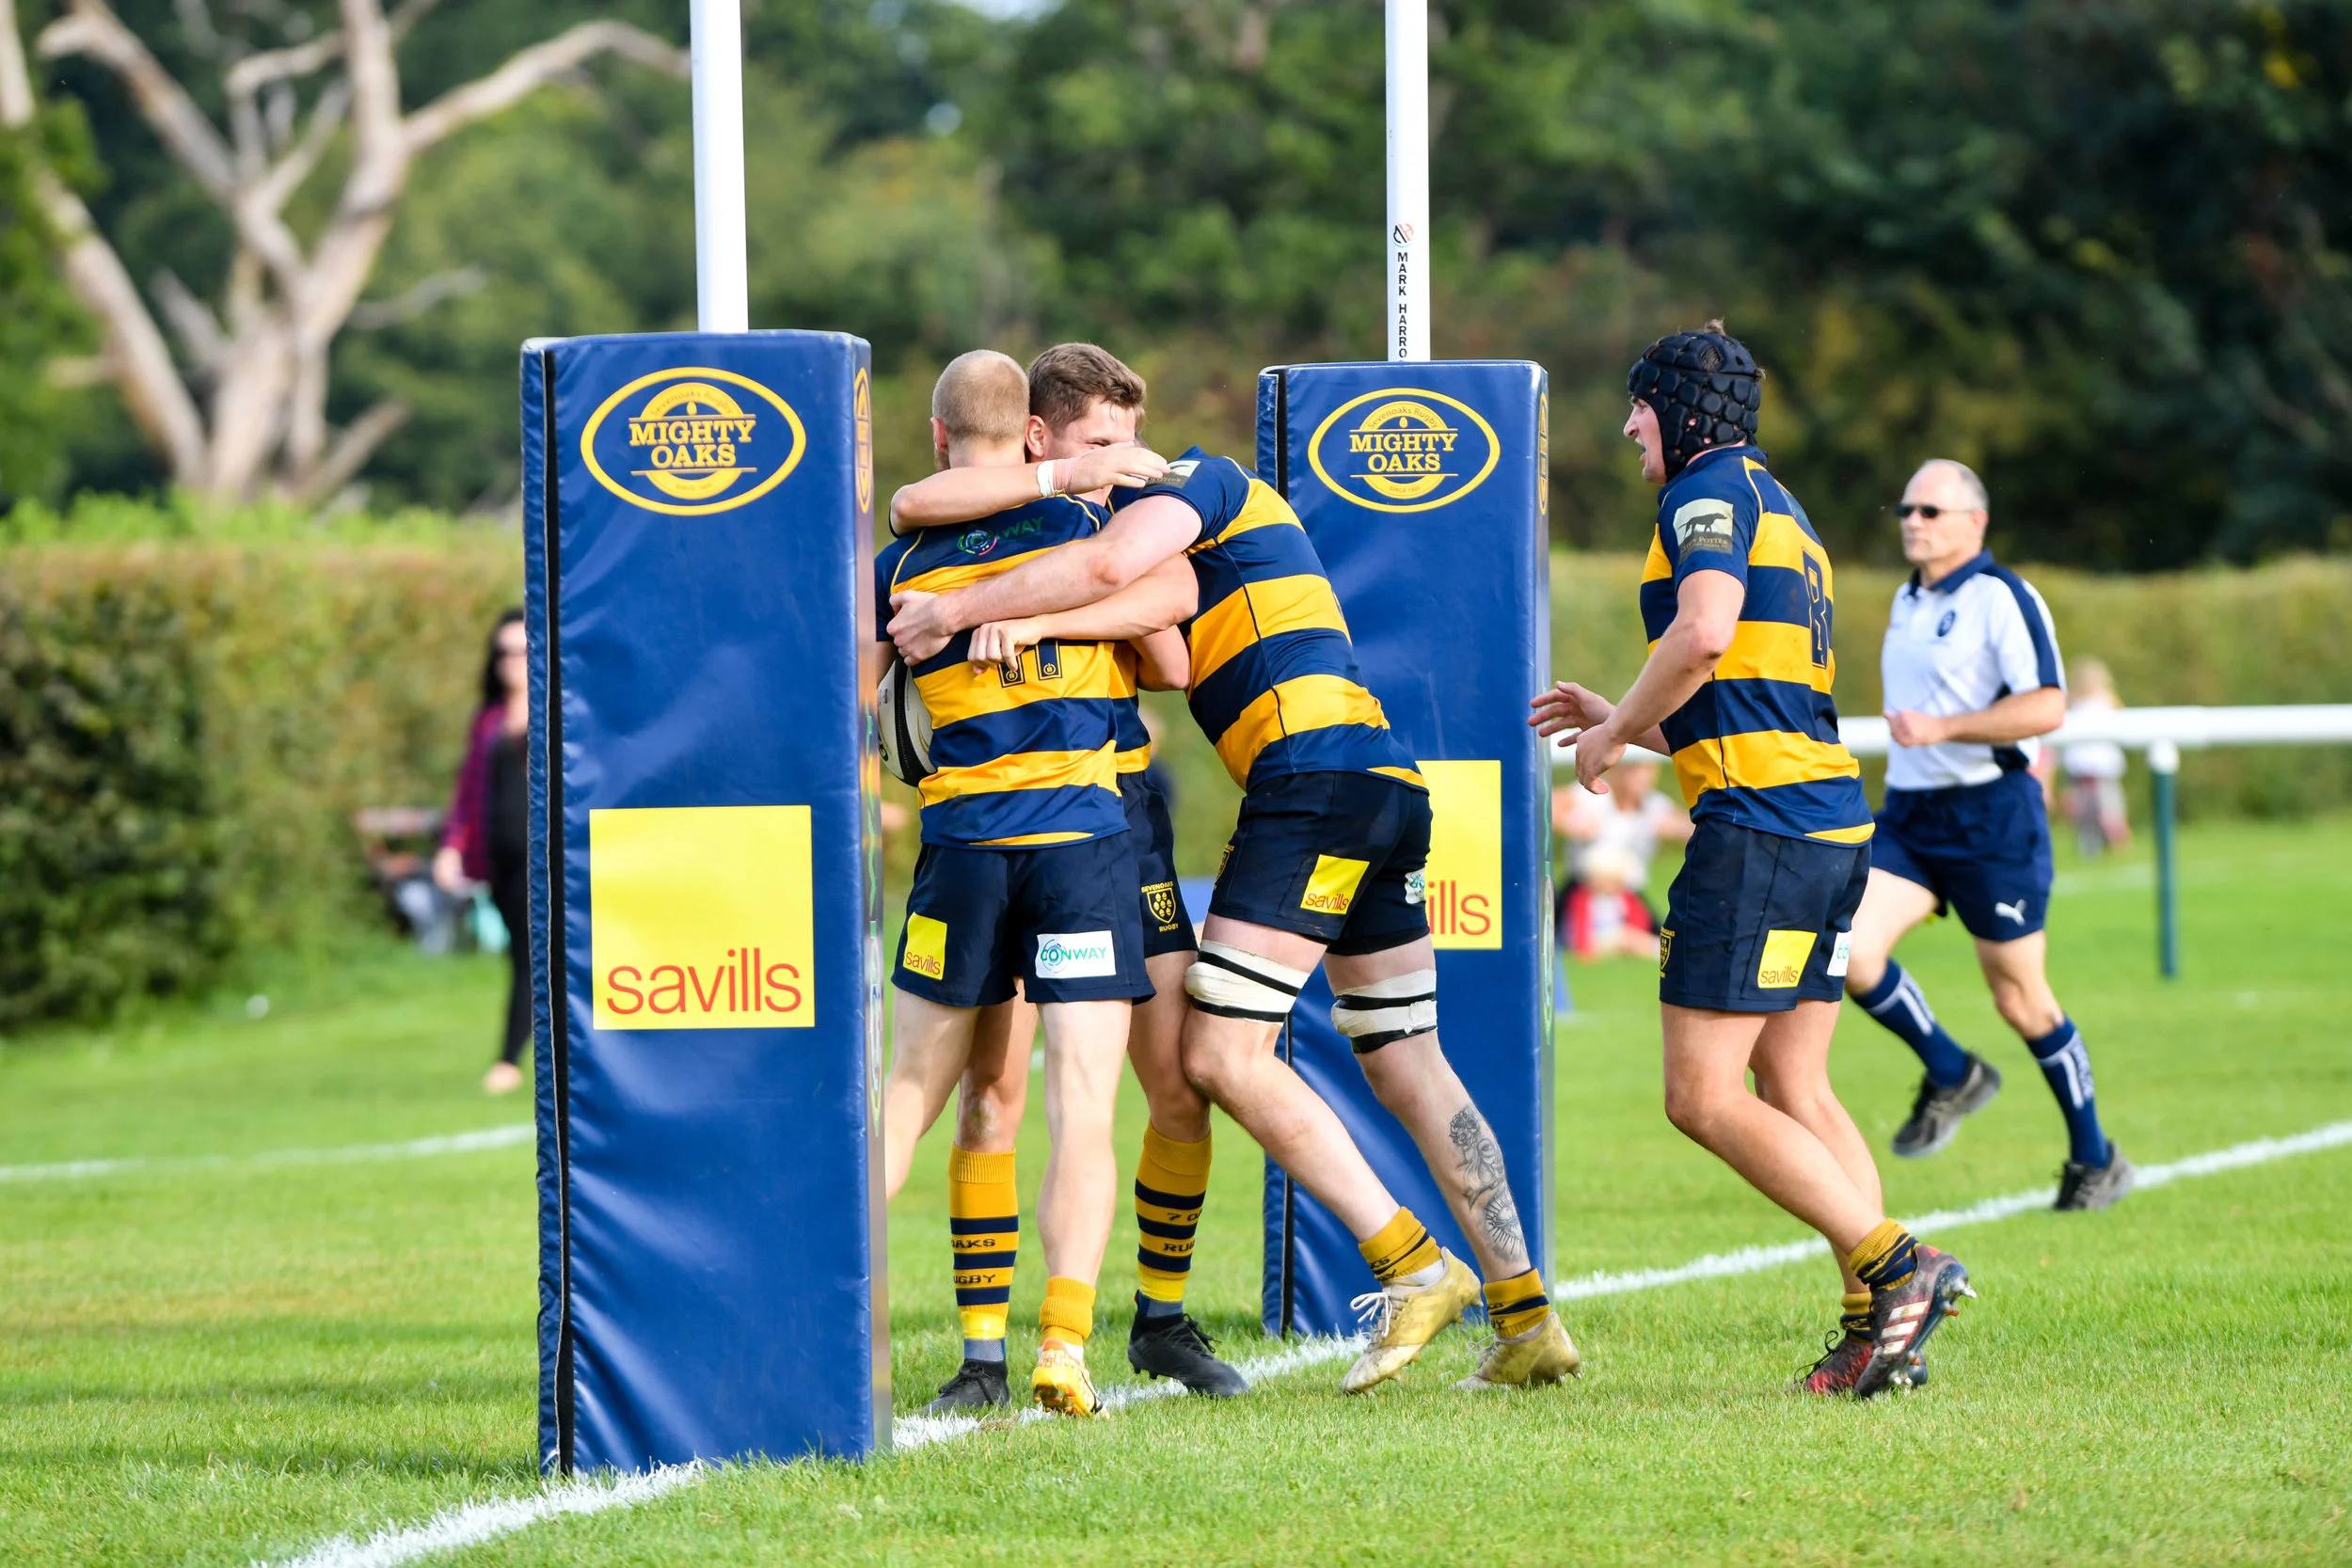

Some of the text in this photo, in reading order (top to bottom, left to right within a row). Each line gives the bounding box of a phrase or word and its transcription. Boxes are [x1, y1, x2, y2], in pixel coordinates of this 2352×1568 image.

[1397, 251, 1408, 296] MARK
[1398, 303, 1407, 361] HARRO
[1368, 405, 1439, 429] Sevenoaks Rugby
[628, 420, 756, 447] MIGHTY
[1349, 433, 1458, 452] MIGHTY
[651, 443, 737, 468] OAKS
[1367, 452, 1441, 473] OAKS
[1140, 880, 1174, 894] SEVENOAKS
[1305, 893, 1349, 911] savills
[1427, 879, 1491, 936] ills
[1158, 923, 1179, 932] RUGBY
[905, 951, 941, 975] savills
[1041, 946, 1107, 961] CONWAY
[606, 946, 803, 1015] savills
[1760, 964, 1799, 984] savills
[1167, 1212, 1183, 1221] 7
[952, 1274, 996, 1284] UGBY
